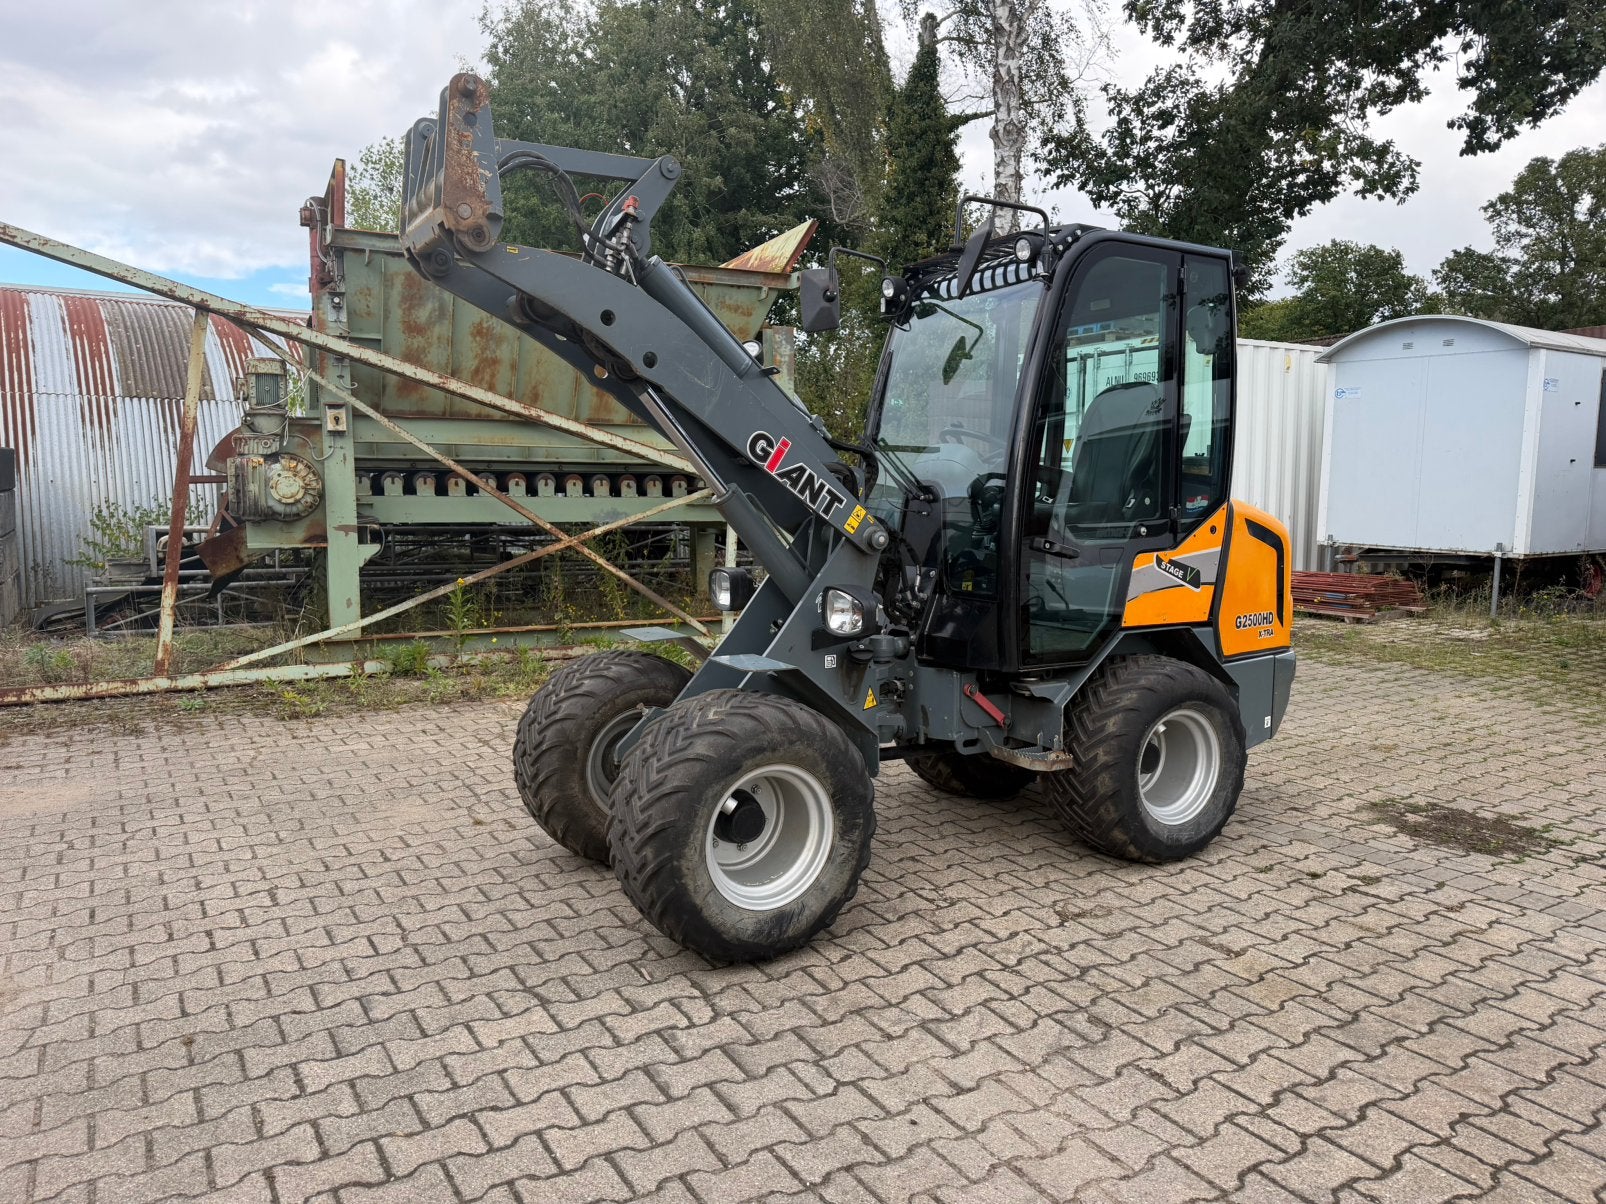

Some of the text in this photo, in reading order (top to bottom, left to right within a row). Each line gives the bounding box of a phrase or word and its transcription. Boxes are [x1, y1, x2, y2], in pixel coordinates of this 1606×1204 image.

[1160, 561, 1184, 579] STAGE
[1235, 611, 1274, 630] G2500HD
[1258, 628, 1274, 639] X-TRA
